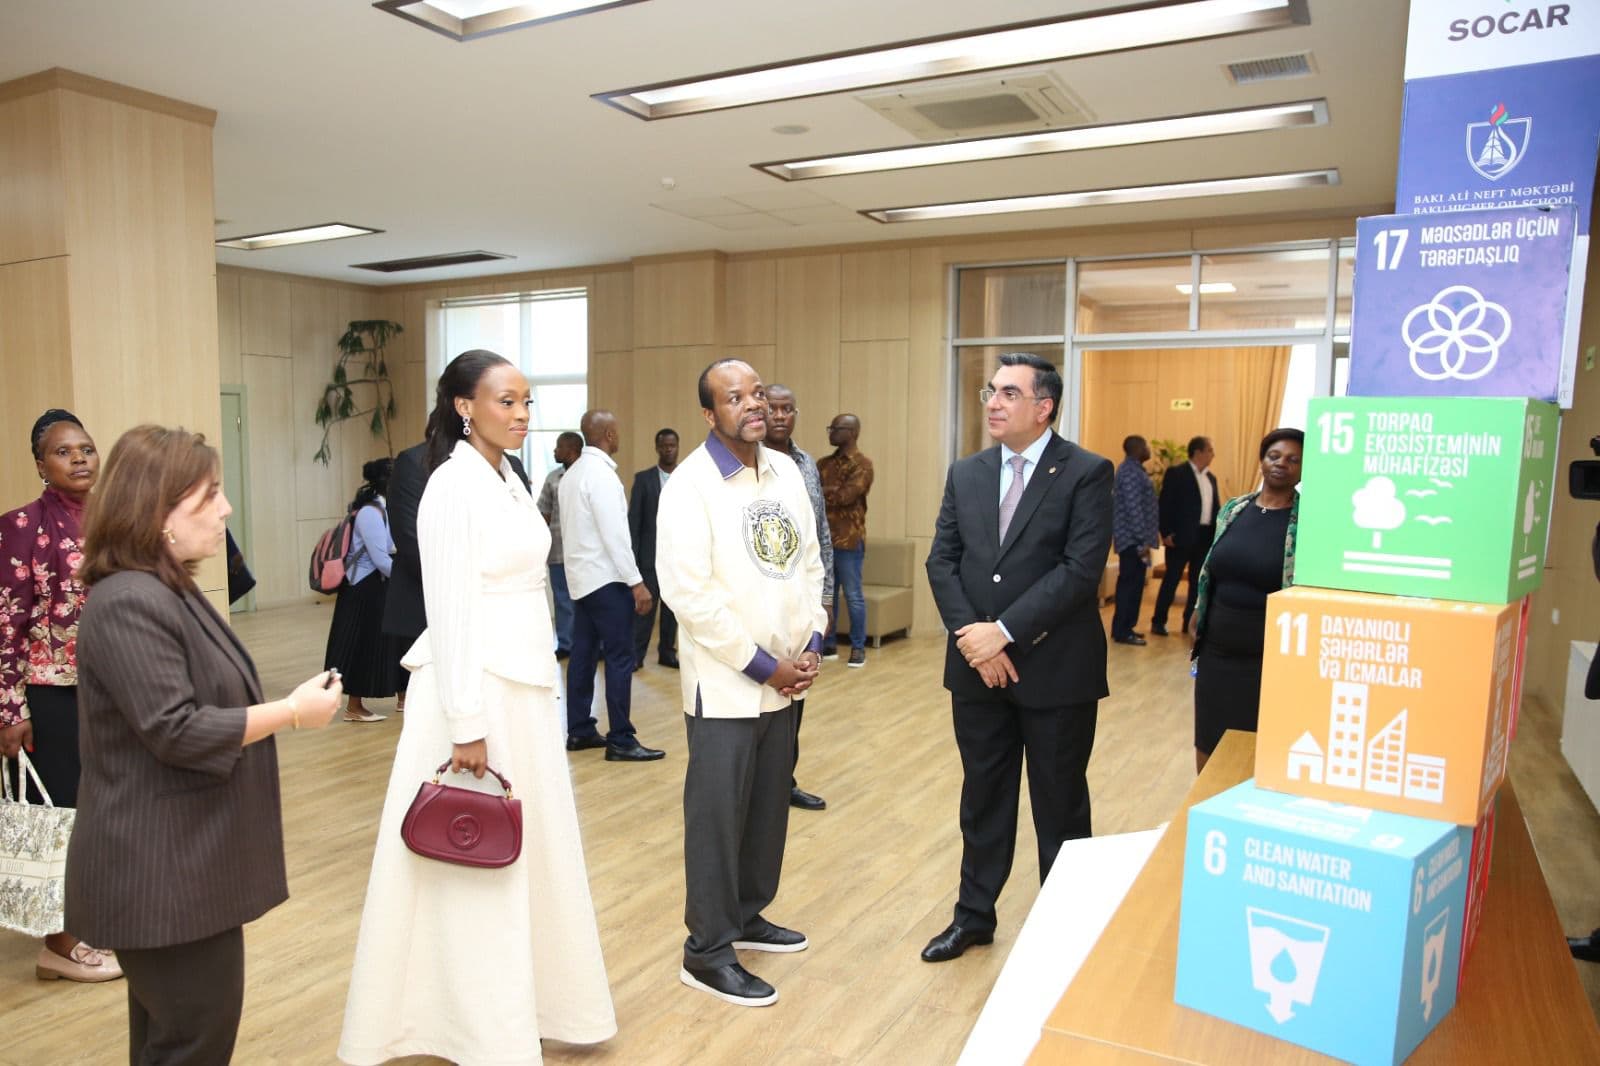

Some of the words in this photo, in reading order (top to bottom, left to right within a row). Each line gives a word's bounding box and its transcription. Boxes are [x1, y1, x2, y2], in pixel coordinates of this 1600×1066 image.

[1447, 3, 1571, 42] SOCAR
[1414, 194, 1444, 204] BAKI
[1447, 189, 1469, 201] ALİ
[1473, 189, 1506, 199] NEFT
[1510, 181, 1575, 197] MƏKTƏBİ
[1420, 221, 1512, 245] MƏQSƏDLƏR
[1516, 216, 1560, 242] ÜÇÜN
[1373, 229, 1409, 271] 17
[1419, 244, 1520, 267] TƏRƏFDAŞLIQ
[1317, 411, 1356, 455] 15
[1366, 412, 1433, 434] TORPAQ
[1364, 431, 1502, 456] EKOSİSTEMİNİN
[1362, 451, 1469, 478] MÜHAFİZƏSİ
[1276, 611, 1309, 657] 11
[1320, 614, 1411, 642] DAYANIQLI
[1318, 657, 1341, 681] VƏ
[1344, 660, 1423, 689] İCMALAR
[1203, 829, 1228, 876] 6
[1244, 836, 1295, 866] CLEAN
[1296, 847, 1352, 881] WATER
[1242, 863, 1276, 889] AND
[1277, 872, 1373, 913] SANITATION
